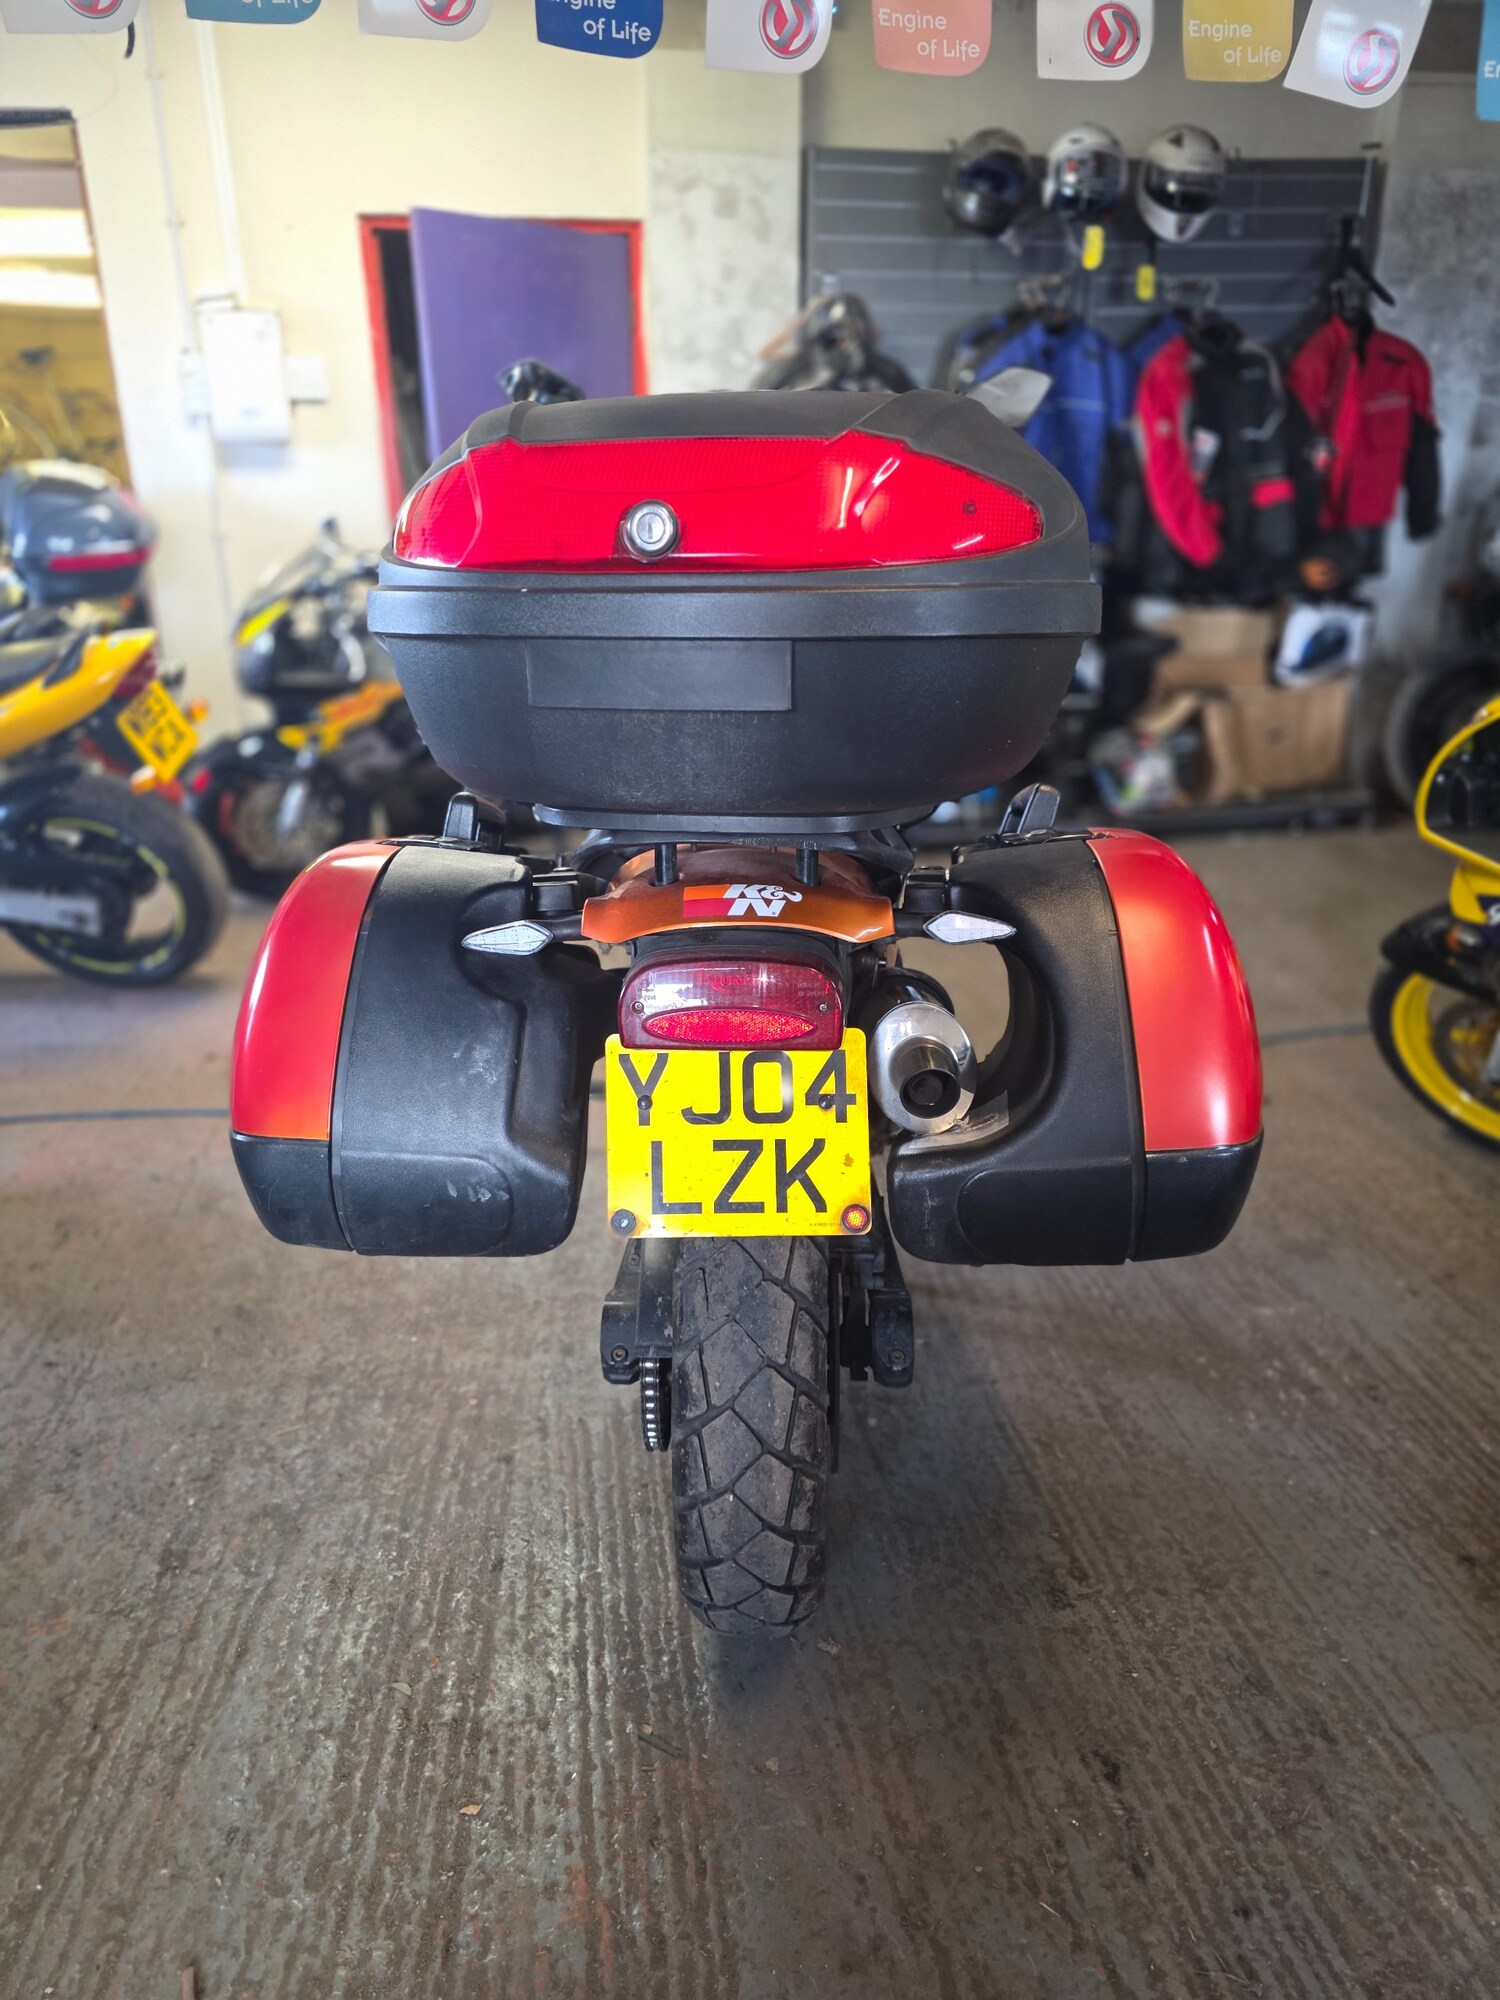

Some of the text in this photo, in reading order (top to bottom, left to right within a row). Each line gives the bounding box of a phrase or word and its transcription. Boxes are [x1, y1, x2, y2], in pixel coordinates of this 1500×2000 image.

[583, 17, 652, 45] of Life
[878, 7, 948, 33] Engine
[1188, 19, 1252, 42] Engine
[917, 38, 981, 62] of Life
[1223, 46, 1282, 67] of Life
[618, 1049, 857, 1127] YJ04
[650, 1138, 828, 1216] LZK
